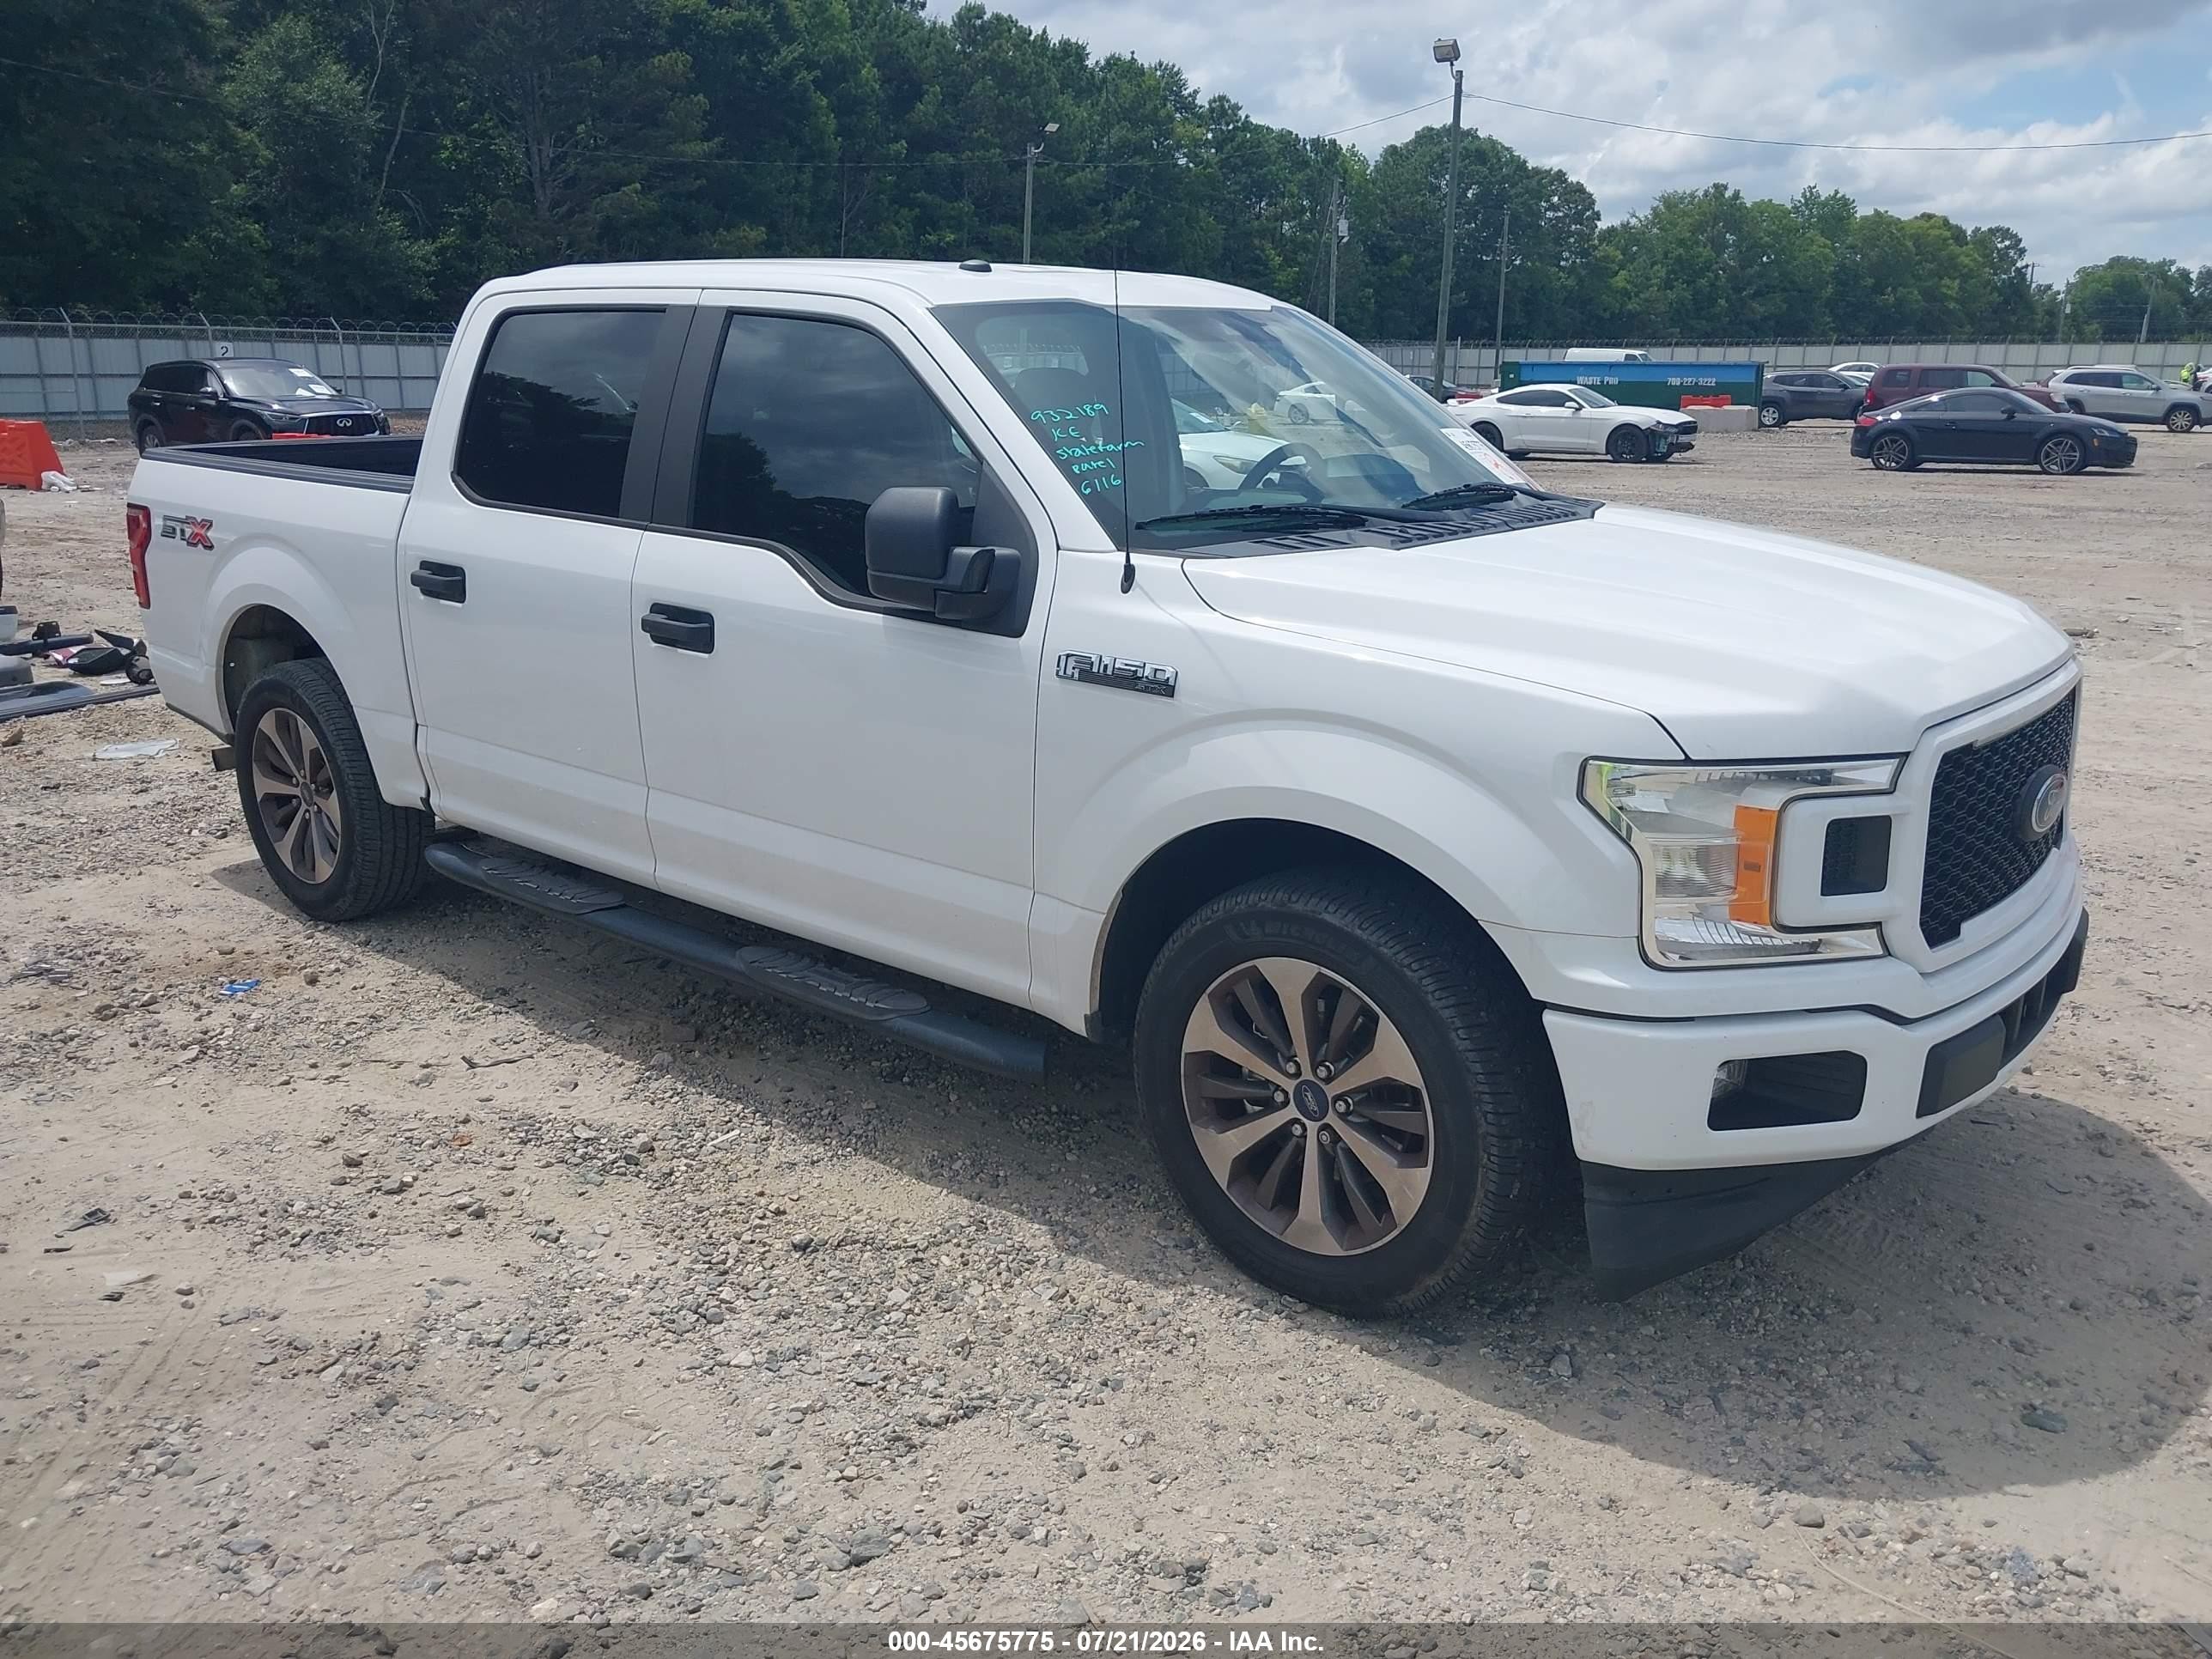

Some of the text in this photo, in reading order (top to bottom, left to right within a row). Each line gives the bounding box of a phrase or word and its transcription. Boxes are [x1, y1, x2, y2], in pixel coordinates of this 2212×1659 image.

[1576, 375, 1601, 386] WASTE
[1030, 402, 1109, 424] 932189
[1080, 473, 1122, 495] 6116
[161, 514, 215, 550] STX
